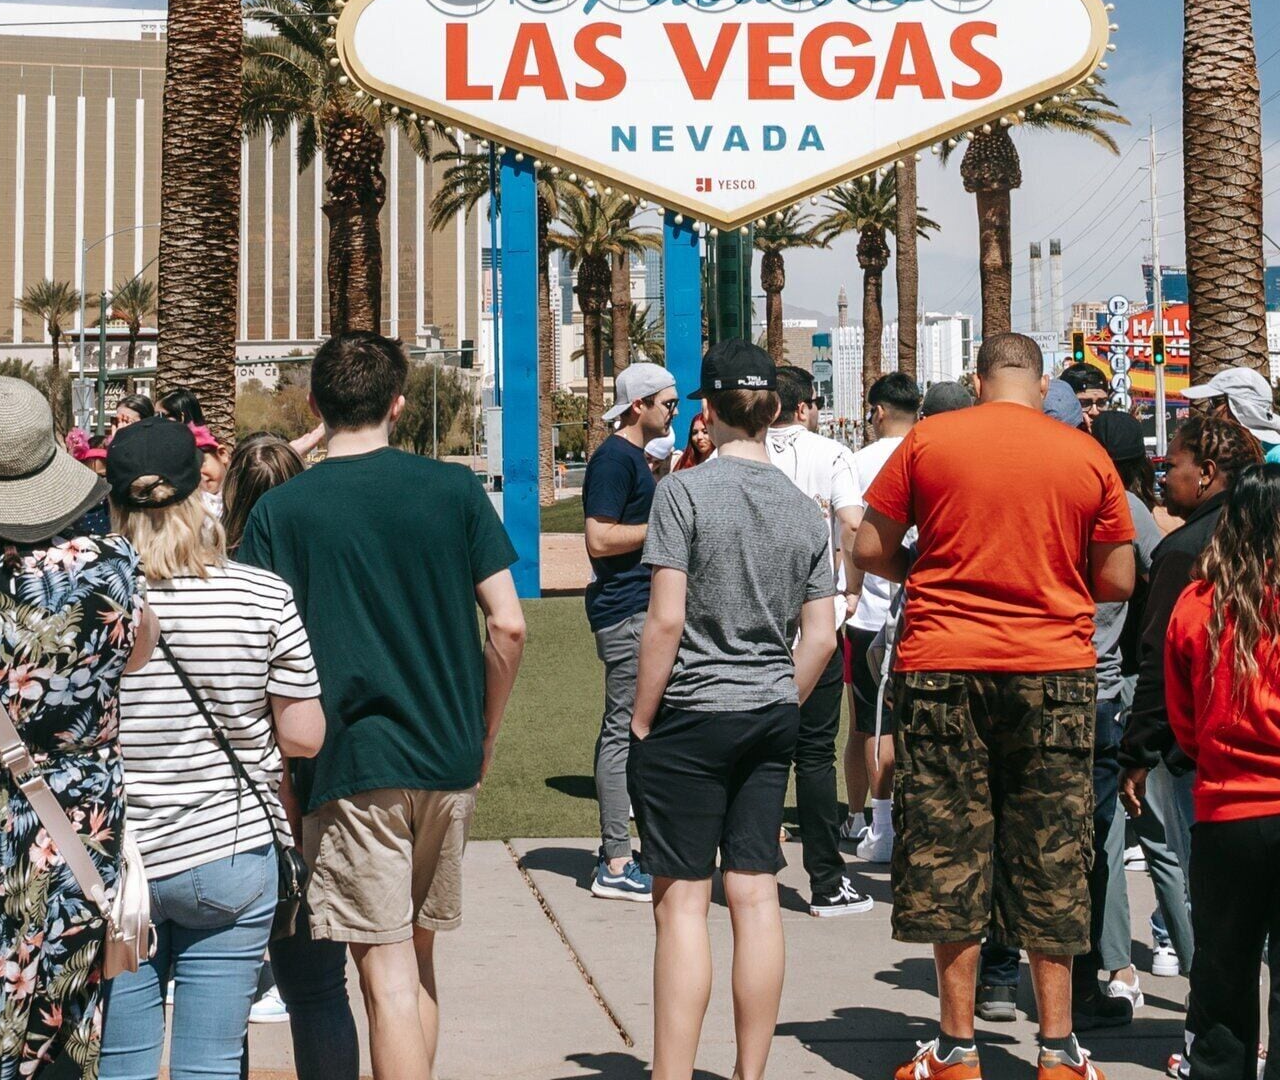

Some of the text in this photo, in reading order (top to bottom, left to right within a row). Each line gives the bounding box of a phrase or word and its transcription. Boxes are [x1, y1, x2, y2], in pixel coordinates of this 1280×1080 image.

[444, 21, 1004, 101] LAS VEGAS
[610, 124, 826, 152] NEVADA
[718, 179, 757, 190] YESCO
